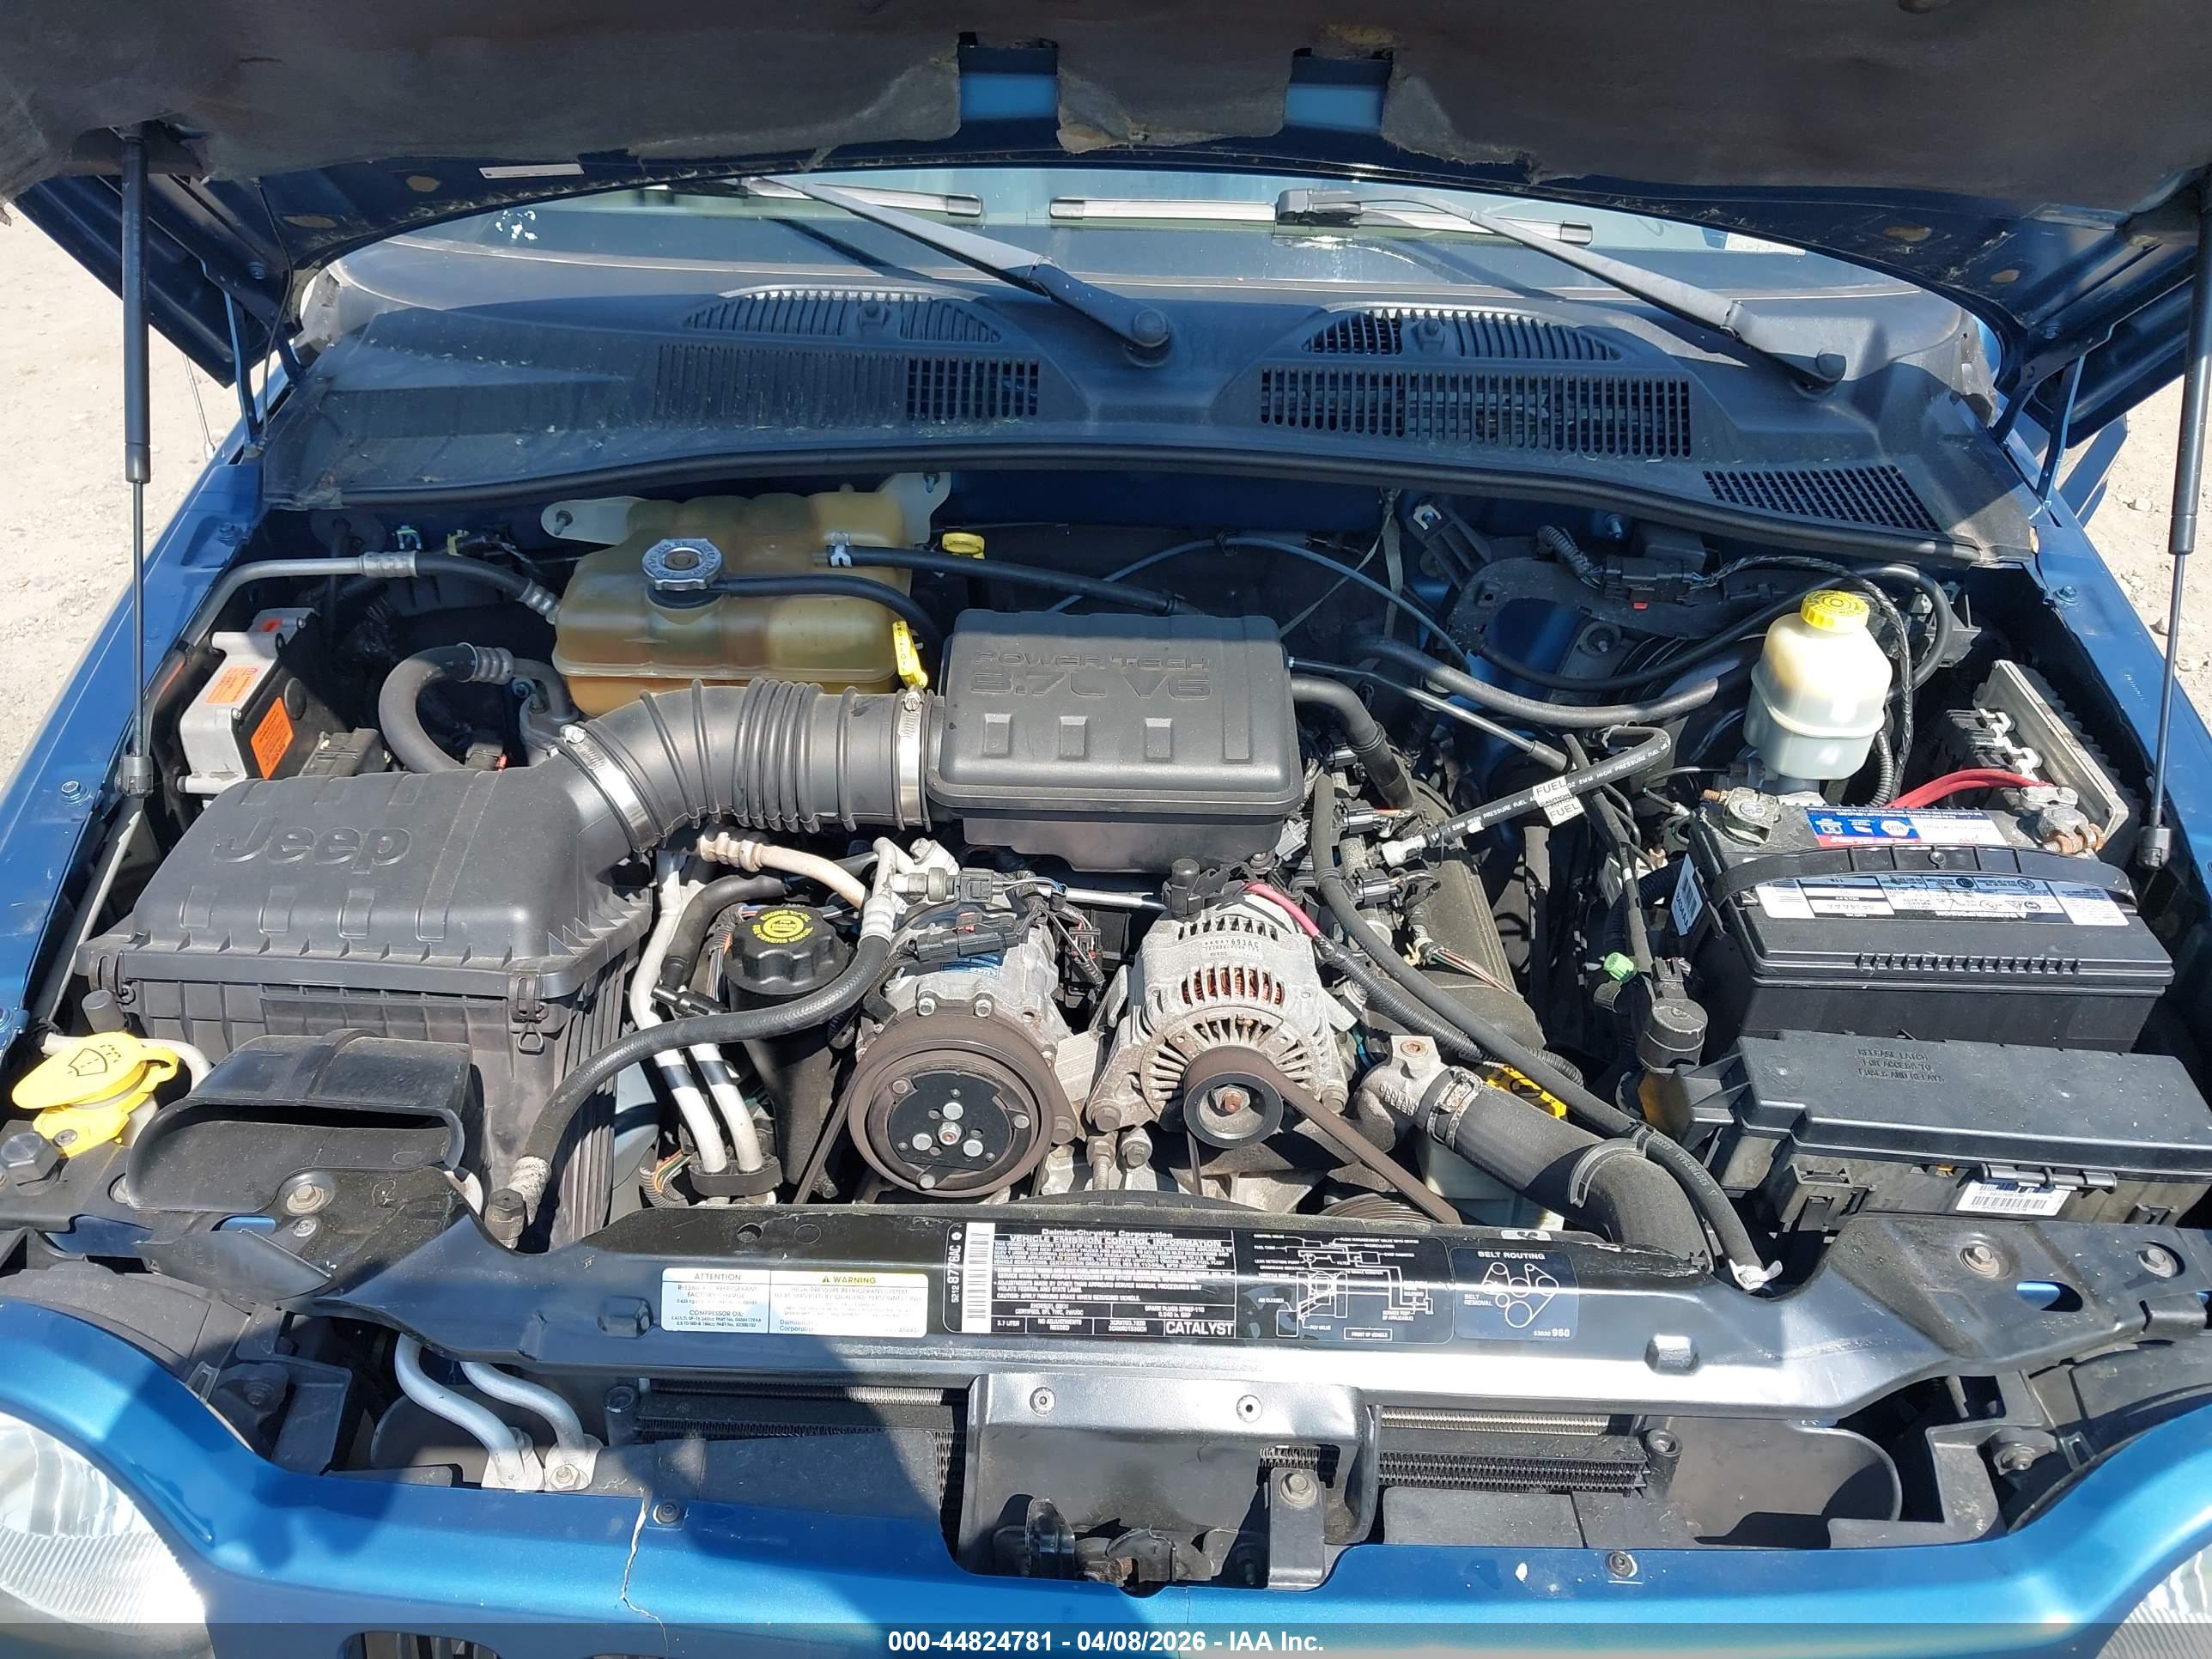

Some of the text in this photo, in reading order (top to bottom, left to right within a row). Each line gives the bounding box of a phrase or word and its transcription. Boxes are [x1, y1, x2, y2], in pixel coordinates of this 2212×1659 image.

[975, 652, 1210, 671] POWER TECH
[971, 672, 1211, 700] 3.7L V6
[1596, 770, 1613, 780] HIGH
[1614, 756, 1646, 772] PRESSURE
[1647, 749, 1660, 759] FUEL
[1536, 780, 1566, 796] FUEL
[1540, 794, 1571, 806] CAUTION
[1483, 804, 1512, 820] PRESSURE
[1513, 799, 1527, 810] FUEL
[1549, 804, 1580, 819] FUEL
[211, 816, 412, 874] Jeep
[1899, 1052, 1929, 1060] LATCH
[1379, 1084, 1418, 1114] COOLANT
[1384, 1095, 1414, 1116] BLEED
[1042, 1228, 1173, 1238] DaimlerChrysler Corporation
[1053, 1236, 1102, 1244] EMISSION
[1104, 1237, 1151, 1245] CONTROL
[1478, 1250, 1501, 1259] BELT
[694, 1273, 742, 1281] ATTENTION
[833, 1276, 877, 1285] WARNING
[951, 1285, 960, 1304] 5212
[1165, 1322, 1234, 1335] CATALYST
[1552, 1328, 1570, 1337] 960
